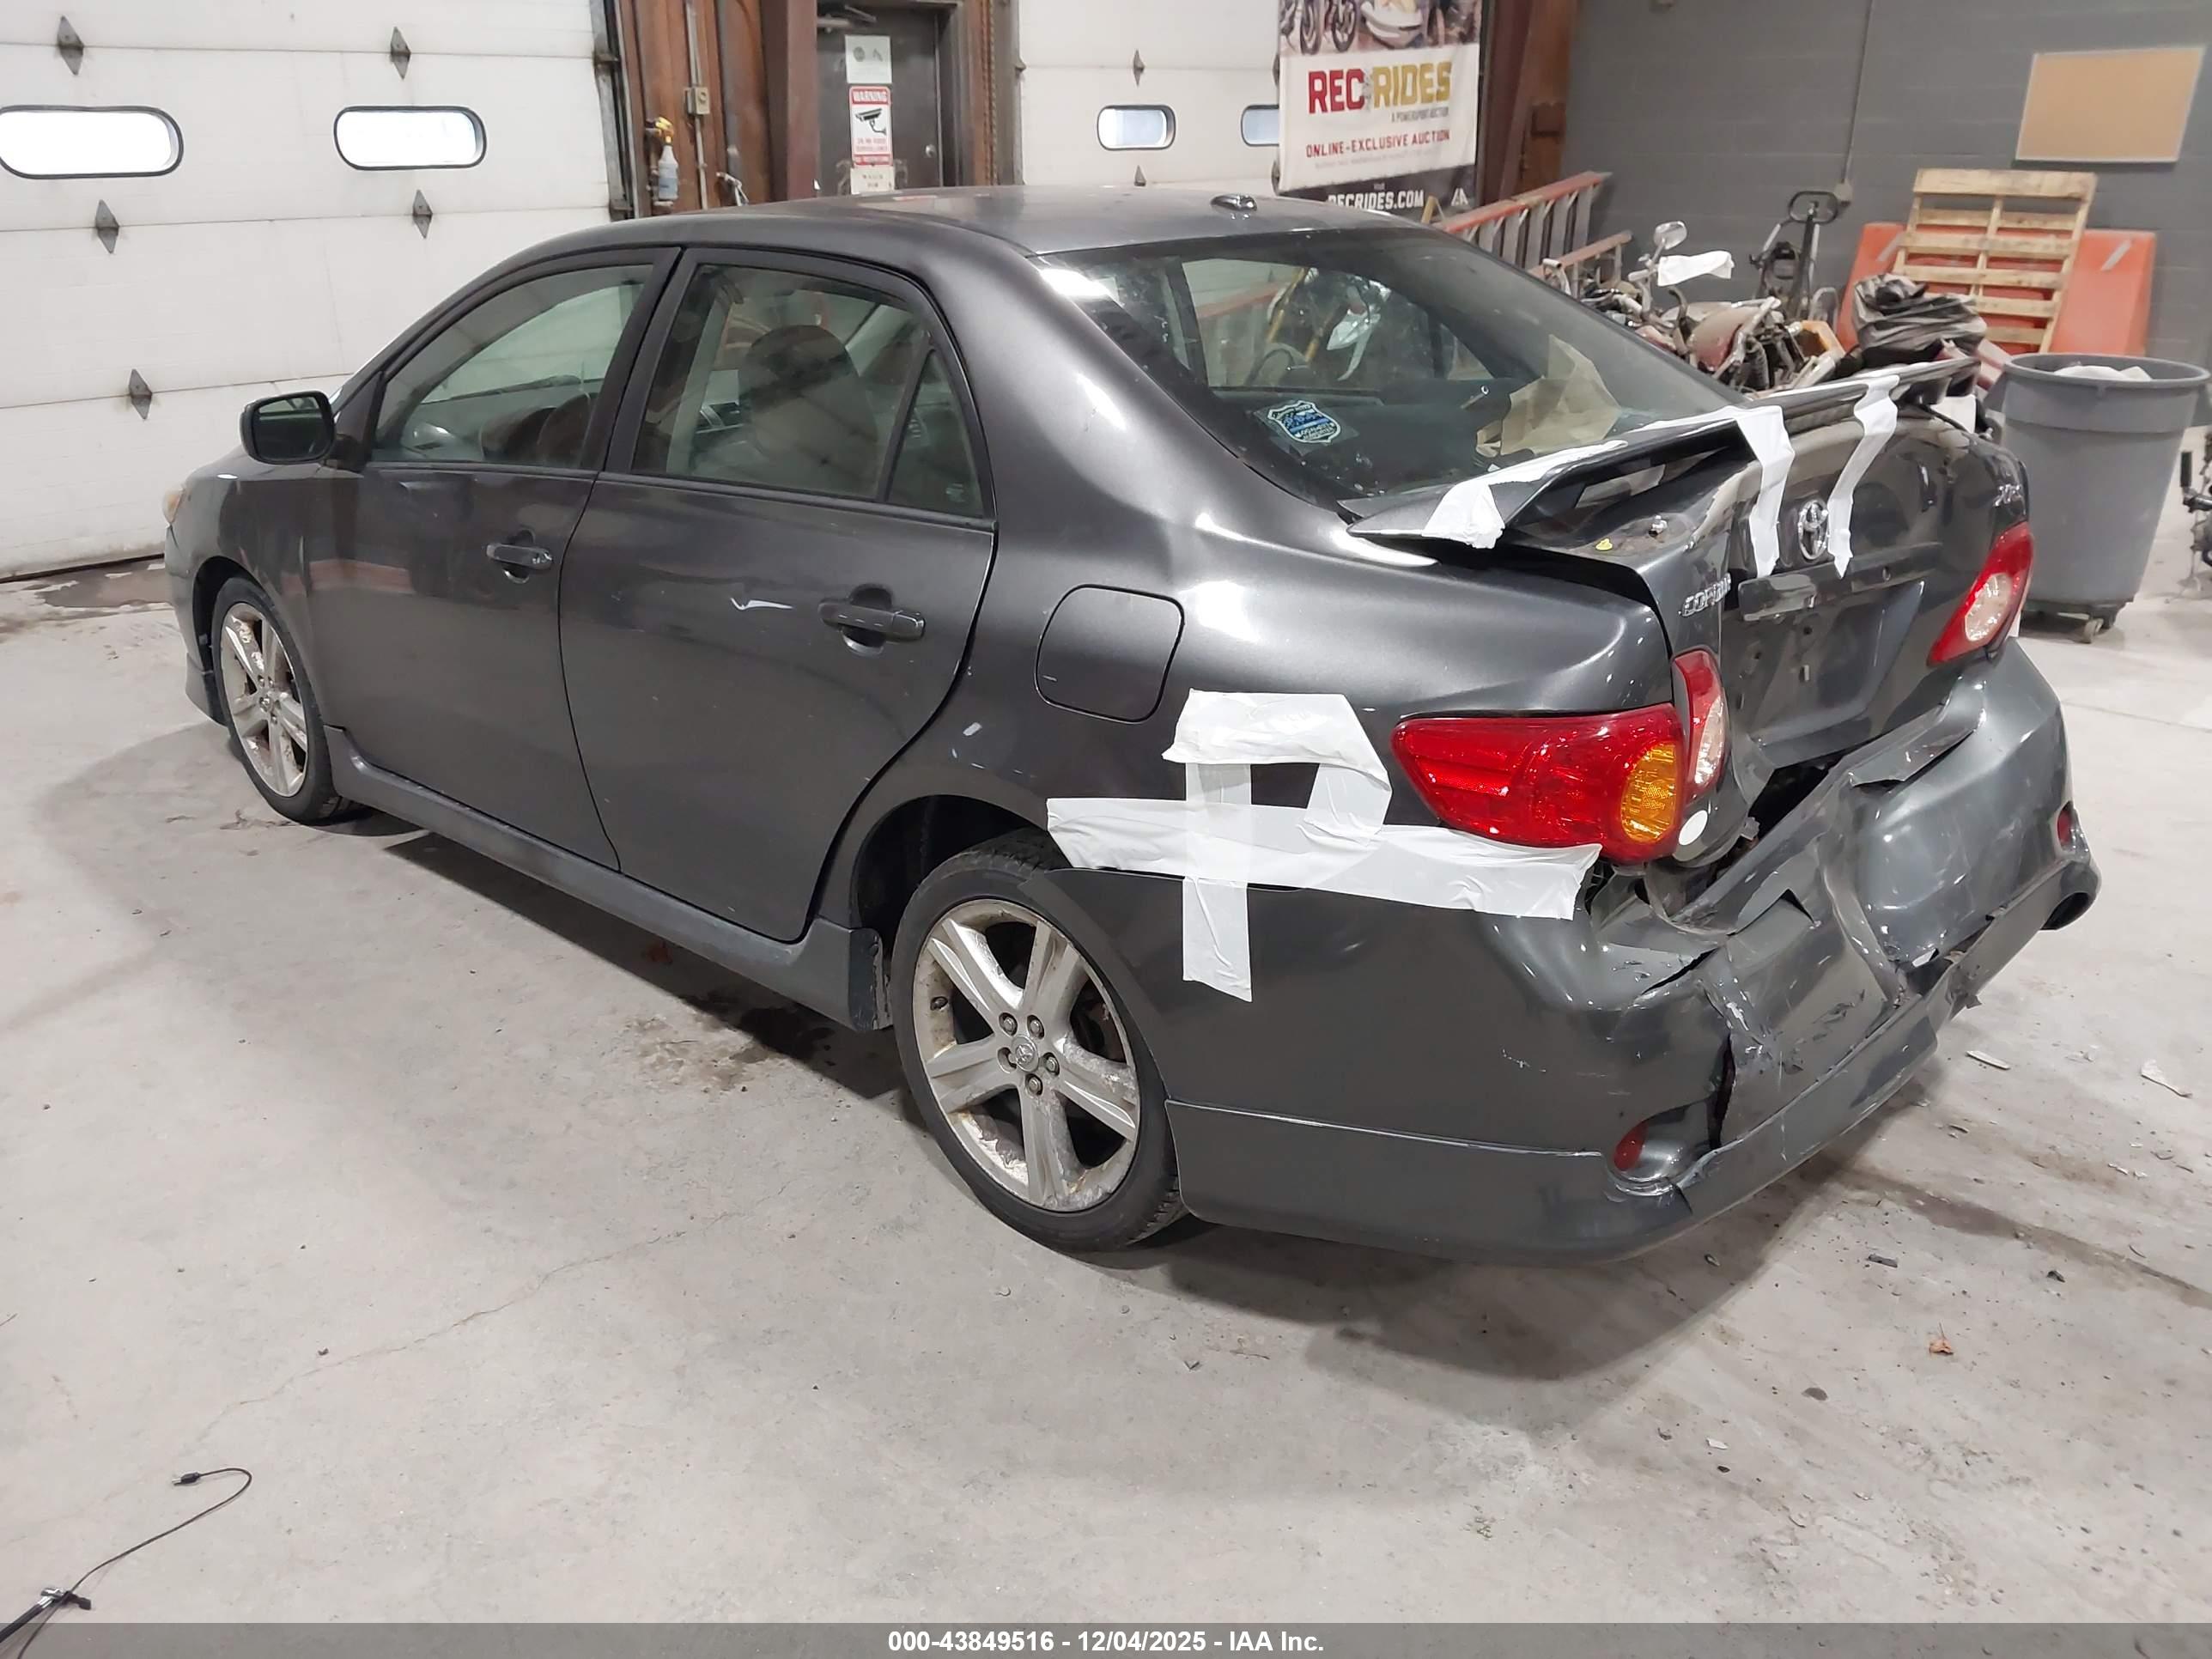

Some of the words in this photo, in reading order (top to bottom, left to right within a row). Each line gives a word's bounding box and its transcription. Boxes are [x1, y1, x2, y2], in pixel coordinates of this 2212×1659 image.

[1309, 69, 1365, 114] REC
[1372, 61, 1452, 108] RIDES
[1306, 134, 1408, 158] ONLINE-EXCLUSIVE
[1411, 129, 1450, 146] AUCTION
